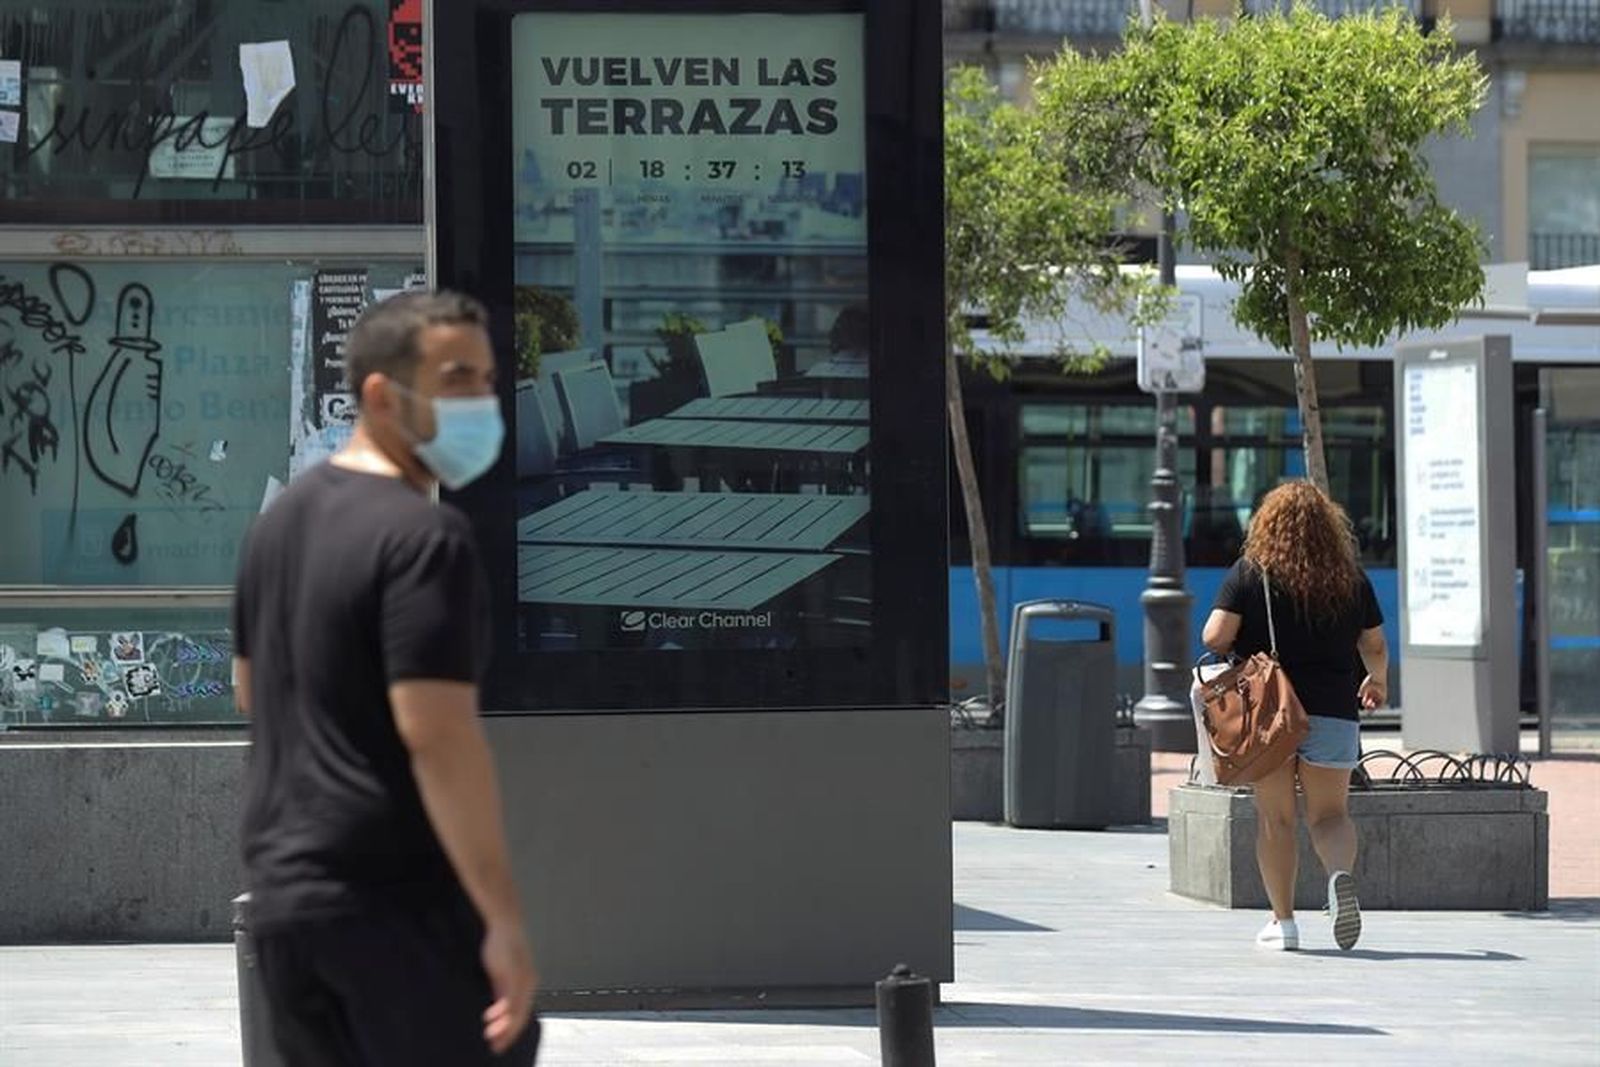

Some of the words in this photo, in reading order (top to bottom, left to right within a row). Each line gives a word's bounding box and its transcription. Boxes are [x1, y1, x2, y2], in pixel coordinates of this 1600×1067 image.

[541, 57, 739, 86] VUELVEN
[758, 58, 838, 86] LAS
[540, 98, 838, 135] TERRAZAS
[567, 161, 597, 179] 02
[639, 161, 665, 179] 18
[707, 161, 736, 179] 37
[782, 160, 806, 178] 13
[648, 612, 696, 629] Clear
[699, 611, 772, 629] Channel
